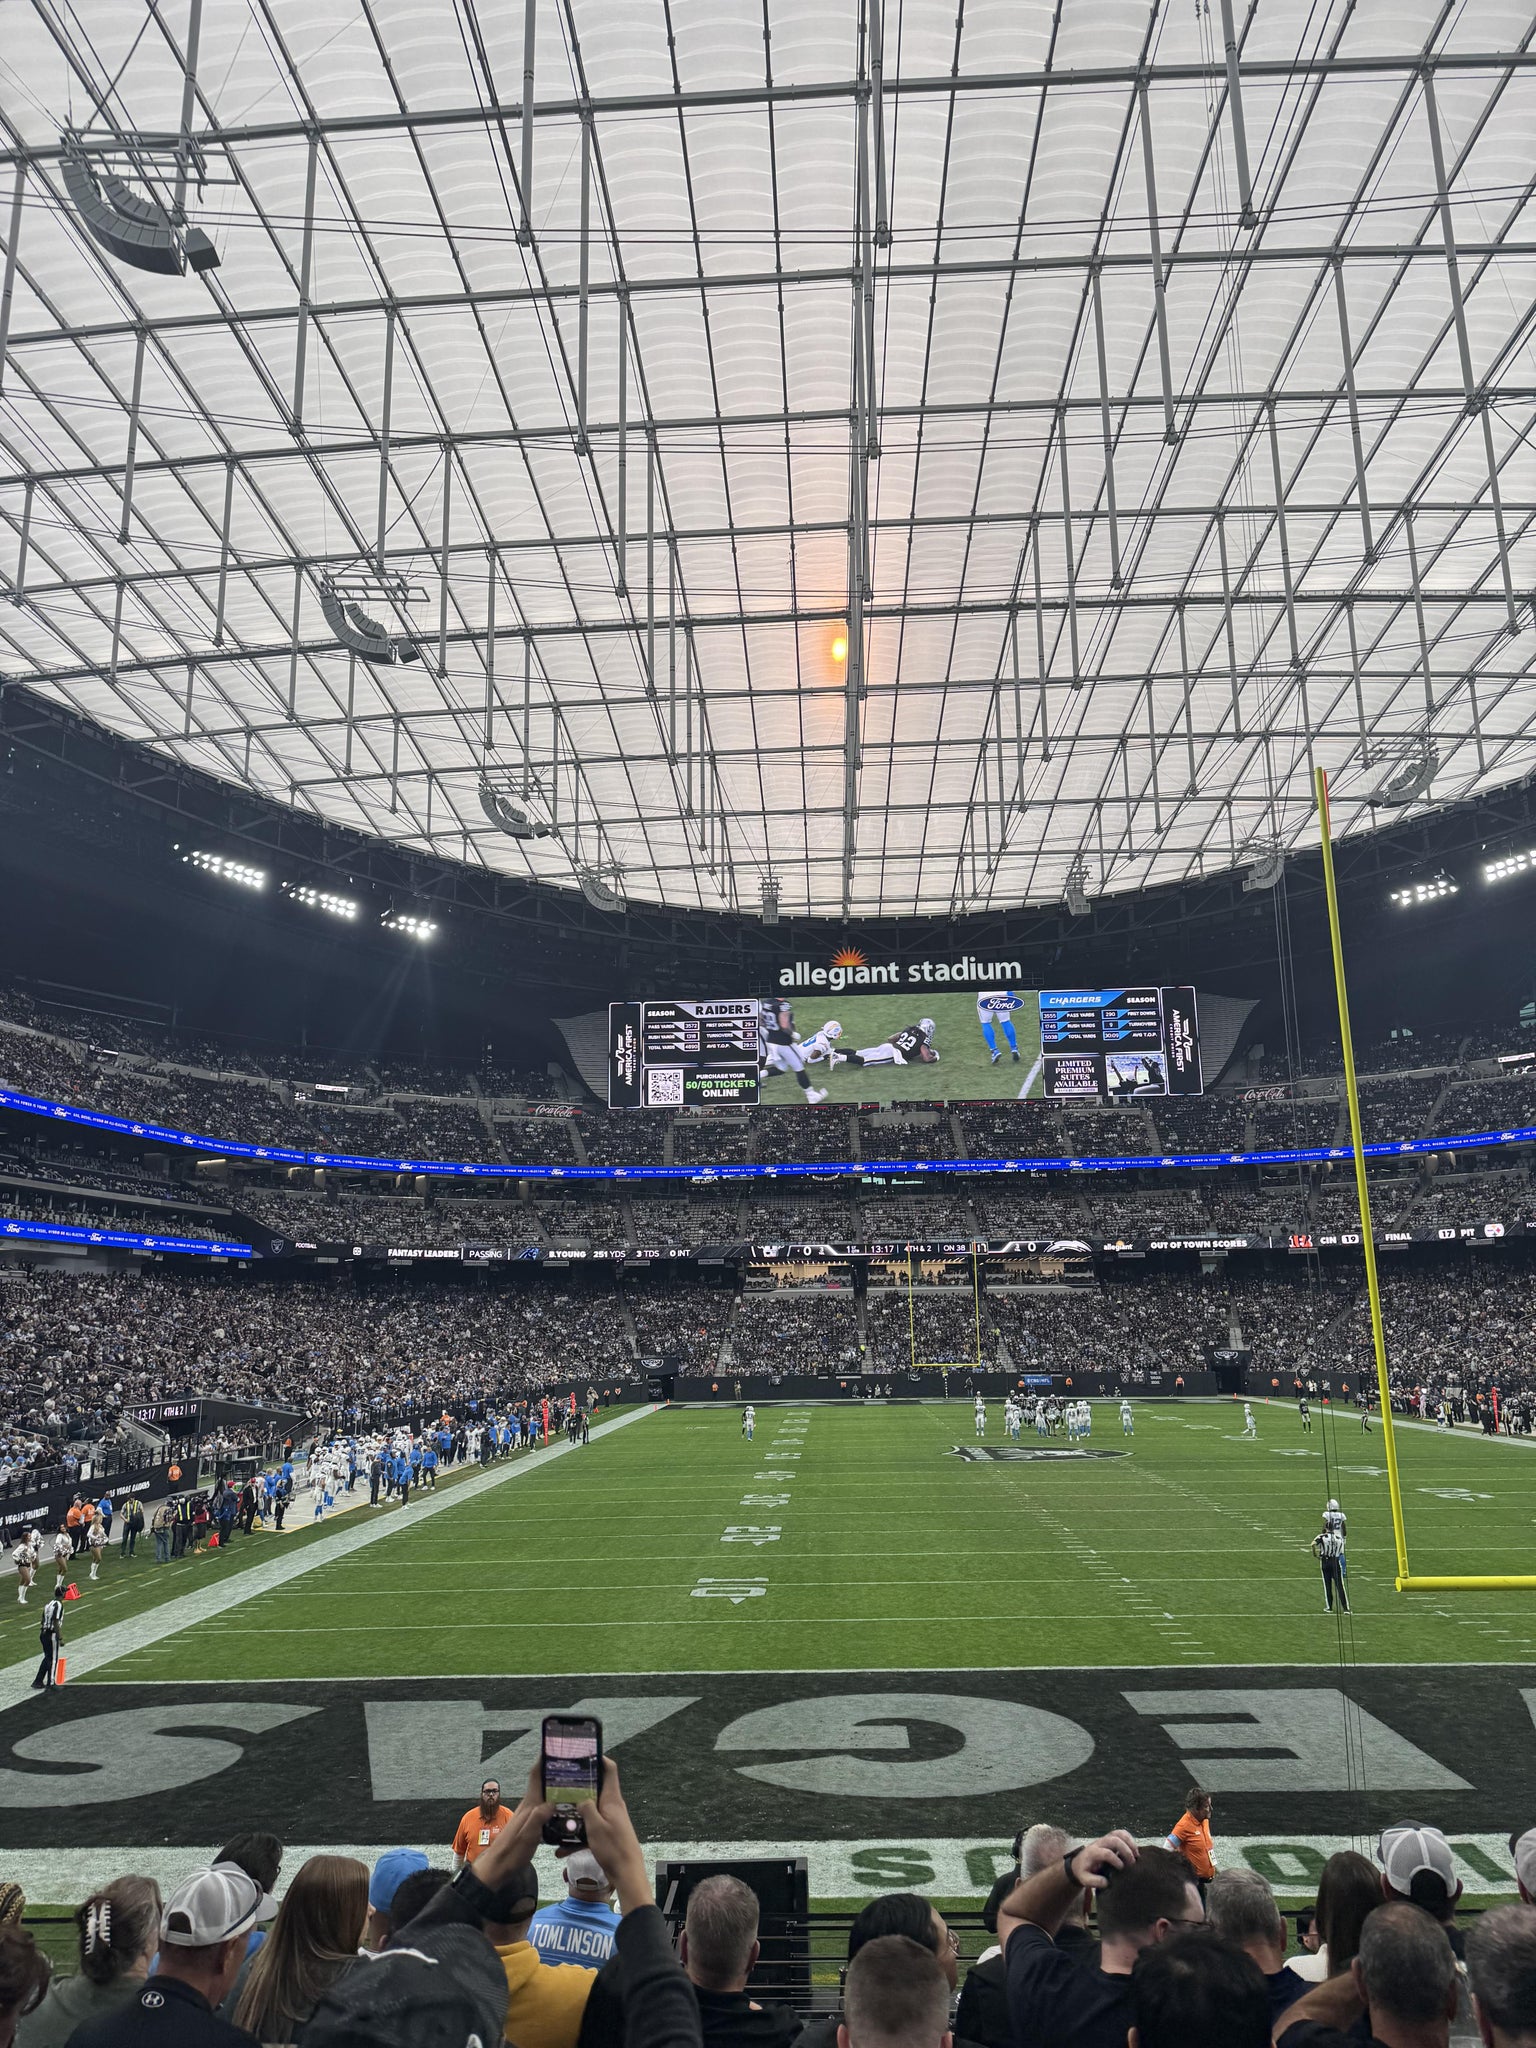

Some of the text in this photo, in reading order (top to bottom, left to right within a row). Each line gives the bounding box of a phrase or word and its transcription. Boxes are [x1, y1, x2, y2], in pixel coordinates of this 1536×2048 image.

[778, 956, 1022, 991] allegiant stadium
[987, 997, 1016, 1010] Ford
[1049, 996, 1102, 1005] CHARGERS
[1126, 996, 1156, 1004] SEASON
[695, 1004, 751, 1016] RAIDERS
[896, 1031, 917, 1052] 22
[1172, 1009, 1185, 1073] AMERICA FIRST
[625, 1024, 633, 1086] AMERICA FIRST
[1060, 1073, 1090, 1081] SUITES
[685, 1079, 756, 1090] 50/50 TICKETS
[1054, 1080, 1098, 1088] AVAILABLE
[702, 1088, 739, 1098] ONLINE
[53, 1107, 68, 1117] Ford
[6, 1223, 21, 1233] Ford
[89, 1233, 103, 1241] Ford
[1385, 1232, 1412, 1241] FINAL
[1442, 1228, 1475, 1239] 17 PIT
[143, 1238, 155, 1246] Ford
[1150, 1239, 1248, 1249] OUT OF TOWN SCORES
[1320, 1235, 1356, 1245] CIN 19
[803, 1246, 812, 1256] 0
[870, 1245, 895, 1254] 13:17
[926, 1244, 932, 1252] 2
[943, 1244, 966, 1252] ON 38
[1027, 1242, 1037, 1252] 0
[1103, 1243, 1133, 1251] allegiant
[388, 1248, 459, 1258] FANTASY LEADERS
[469, 1250, 503, 1258] PASSING
[548, 1250, 587, 1258] B.YOUNG
[593, 1250, 626, 1258] 251 YDS
[636, 1249, 660, 1258] 3 TDS
[669, 1249, 691, 1257] 0 INT
[138, 1407, 156, 1420] 13:17
[163, 1407, 175, 1417] 4TH
[179, 1406, 184, 1415] 2
[190, 1404, 197, 1414] 17
[116, 1485, 131, 1496] VEGAS
[531, 1923, 614, 1961] TOMLINSON
